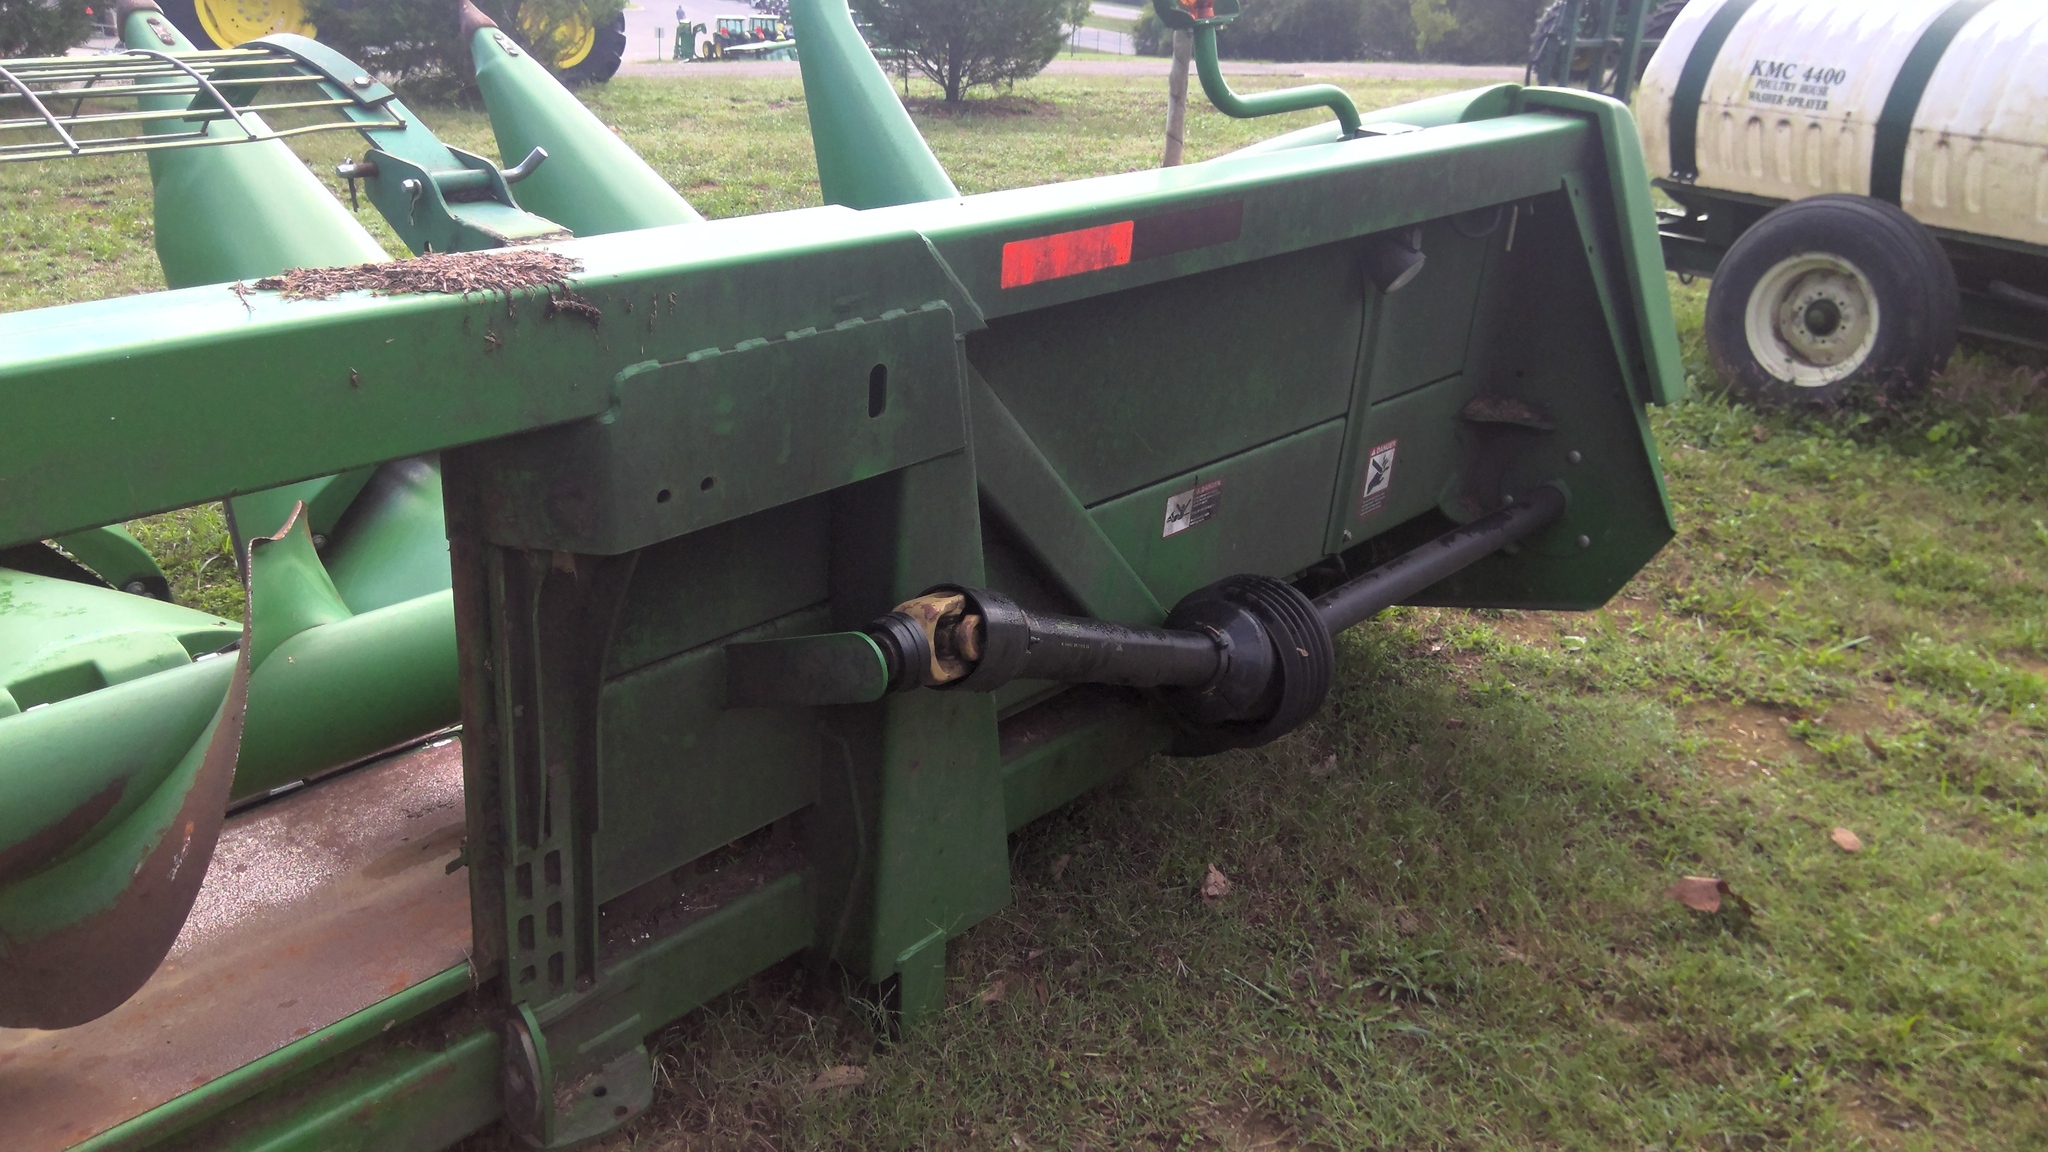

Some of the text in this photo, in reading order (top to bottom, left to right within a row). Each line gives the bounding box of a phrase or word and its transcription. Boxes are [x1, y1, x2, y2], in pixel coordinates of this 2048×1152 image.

[1749, 59, 1847, 86] KMC 4400
[1755, 78, 1829, 97] POULTRY HOUSE
[1376, 440, 1397, 454] DANGER
